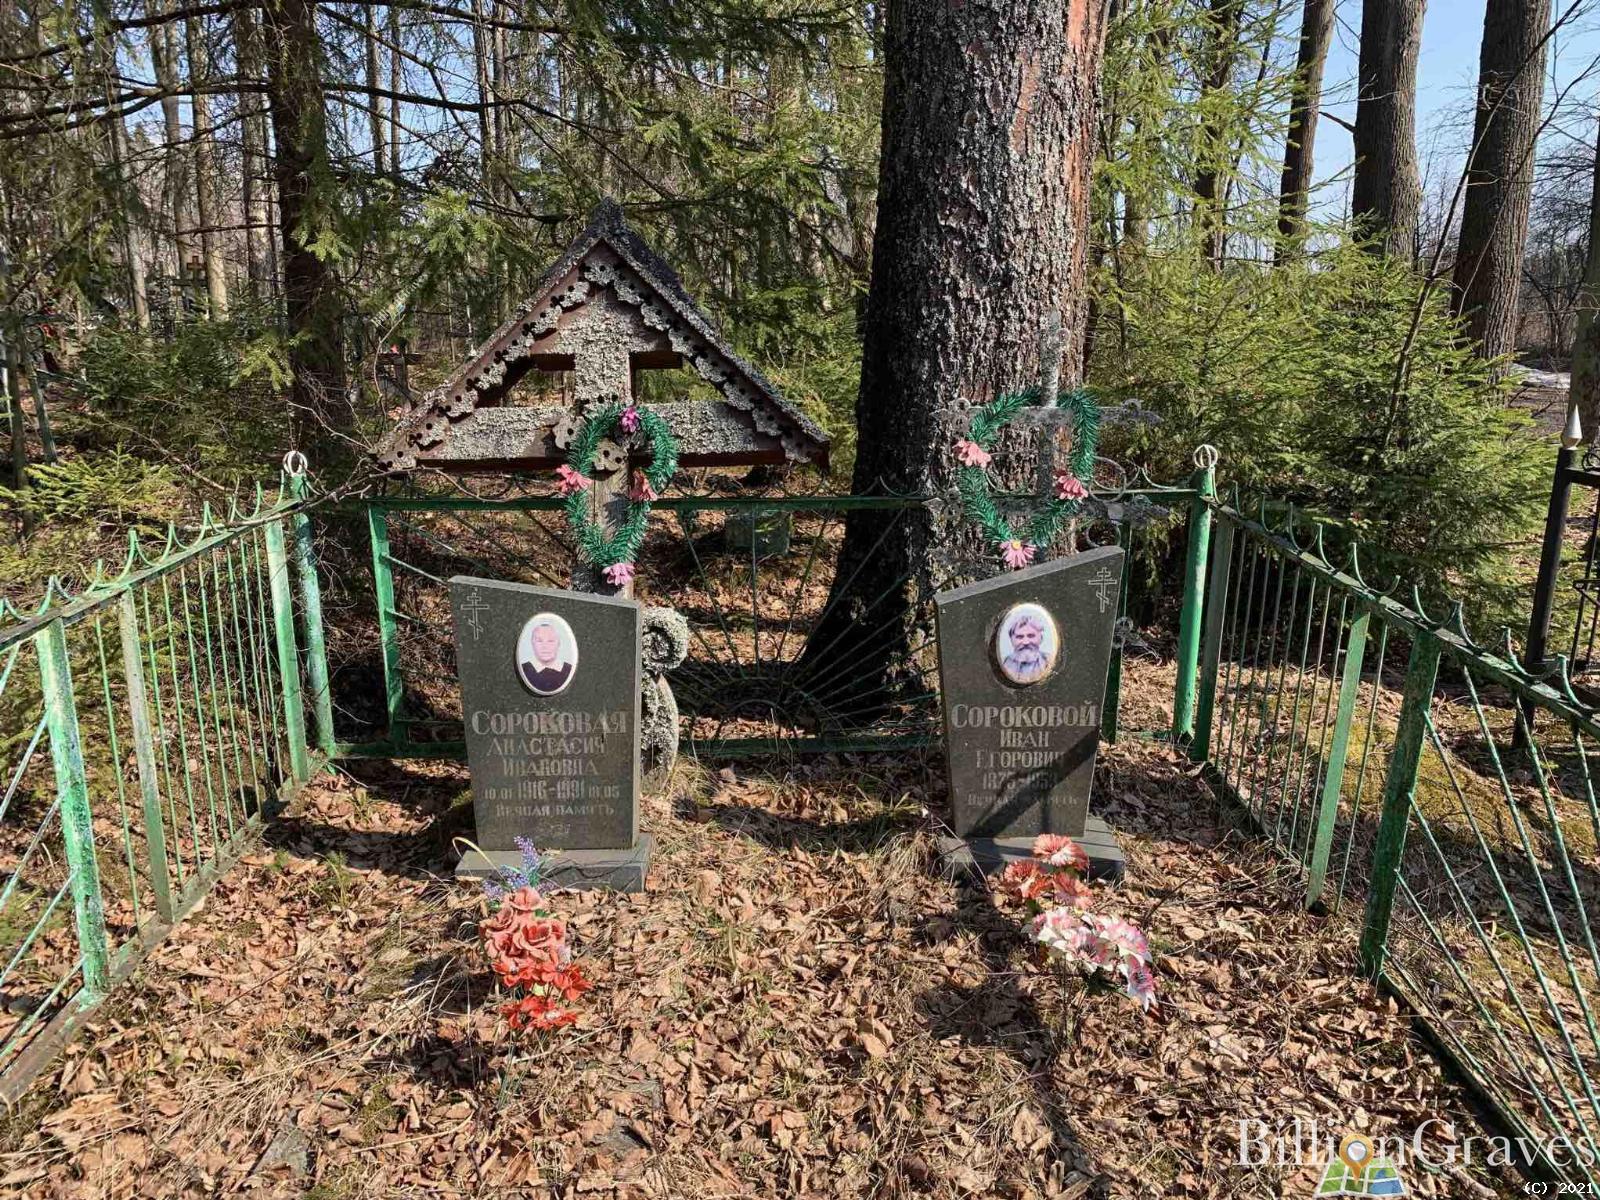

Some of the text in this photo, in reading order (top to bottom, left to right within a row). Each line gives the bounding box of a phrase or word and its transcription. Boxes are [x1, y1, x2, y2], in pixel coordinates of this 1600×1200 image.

[471, 710, 628, 735] СОРОКОВАЯ
[952, 700, 1098, 728] СОРОКОВОЙ
[1000, 729, 1049, 748] ИВАН
